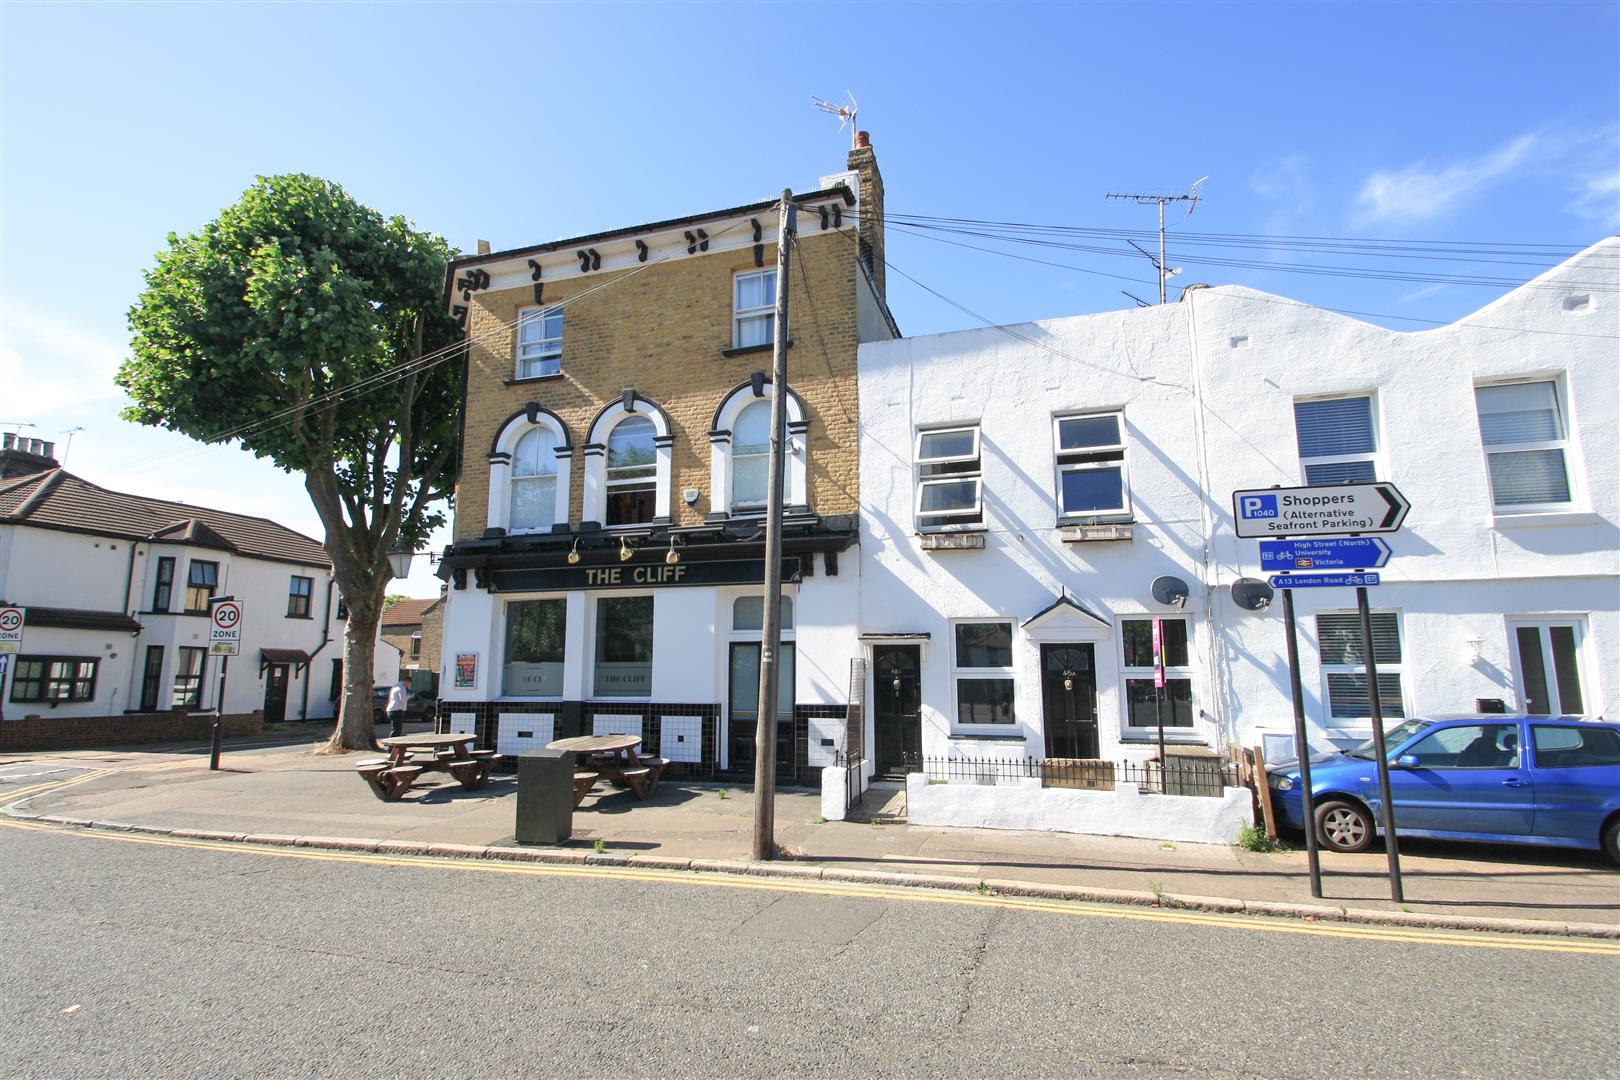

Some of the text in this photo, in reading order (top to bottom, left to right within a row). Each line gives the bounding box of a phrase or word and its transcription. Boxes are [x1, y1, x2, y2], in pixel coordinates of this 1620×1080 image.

[1283, 495, 1354, 506] Shoppers
[1245, 498, 1262, 517] P
[1268, 521, 1317, 530] Seafront
[1338, 539, 1370, 547] (North)
[586, 566, 686, 584] THE CLIFF
[2, 616, 19, 625] 20
[219, 611, 236, 621] 20
[606, 675, 645, 683] THE CLIFF
